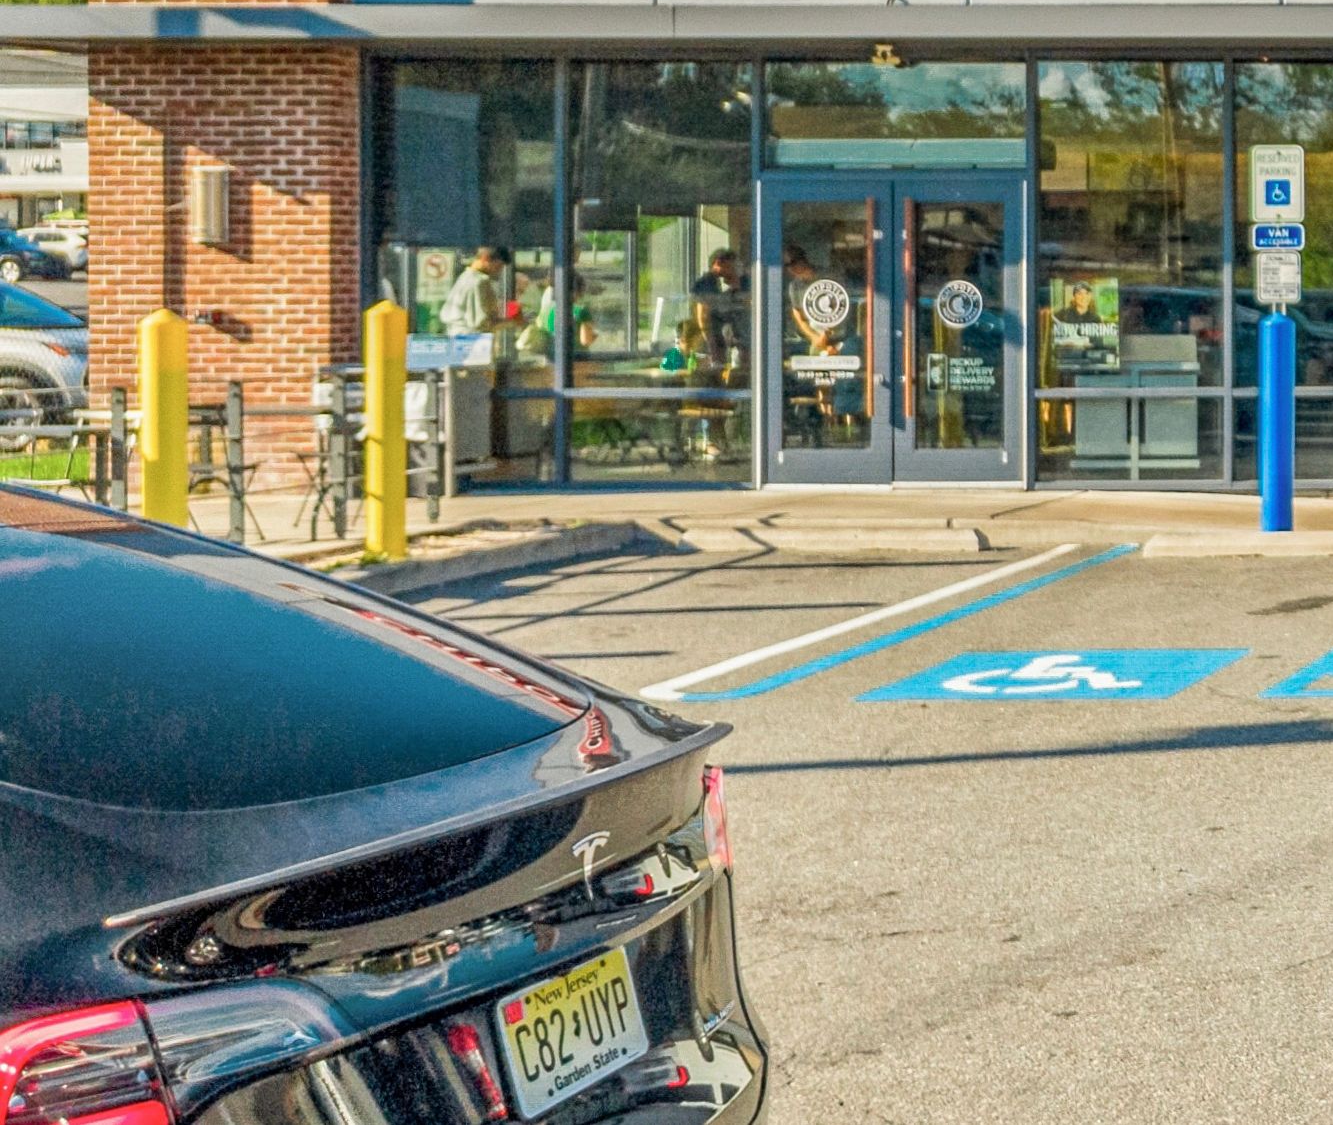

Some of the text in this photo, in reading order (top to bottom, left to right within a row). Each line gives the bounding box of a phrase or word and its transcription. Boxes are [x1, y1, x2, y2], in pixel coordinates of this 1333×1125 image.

[1256, 153, 1300, 163] RESERVED
[1259, 167, 1297, 176] PARKING
[1268, 228, 1290, 238] VAN
[1053, 322, 1119, 336] NOW HIRING
[950, 358, 983, 366] PICKUP
[950, 366, 994, 375] DELIVERY
[950, 376, 995, 385] REWARDS
[533, 970, 599, 1011] New Jersey
[553, 1047, 621, 1091] Garden State
